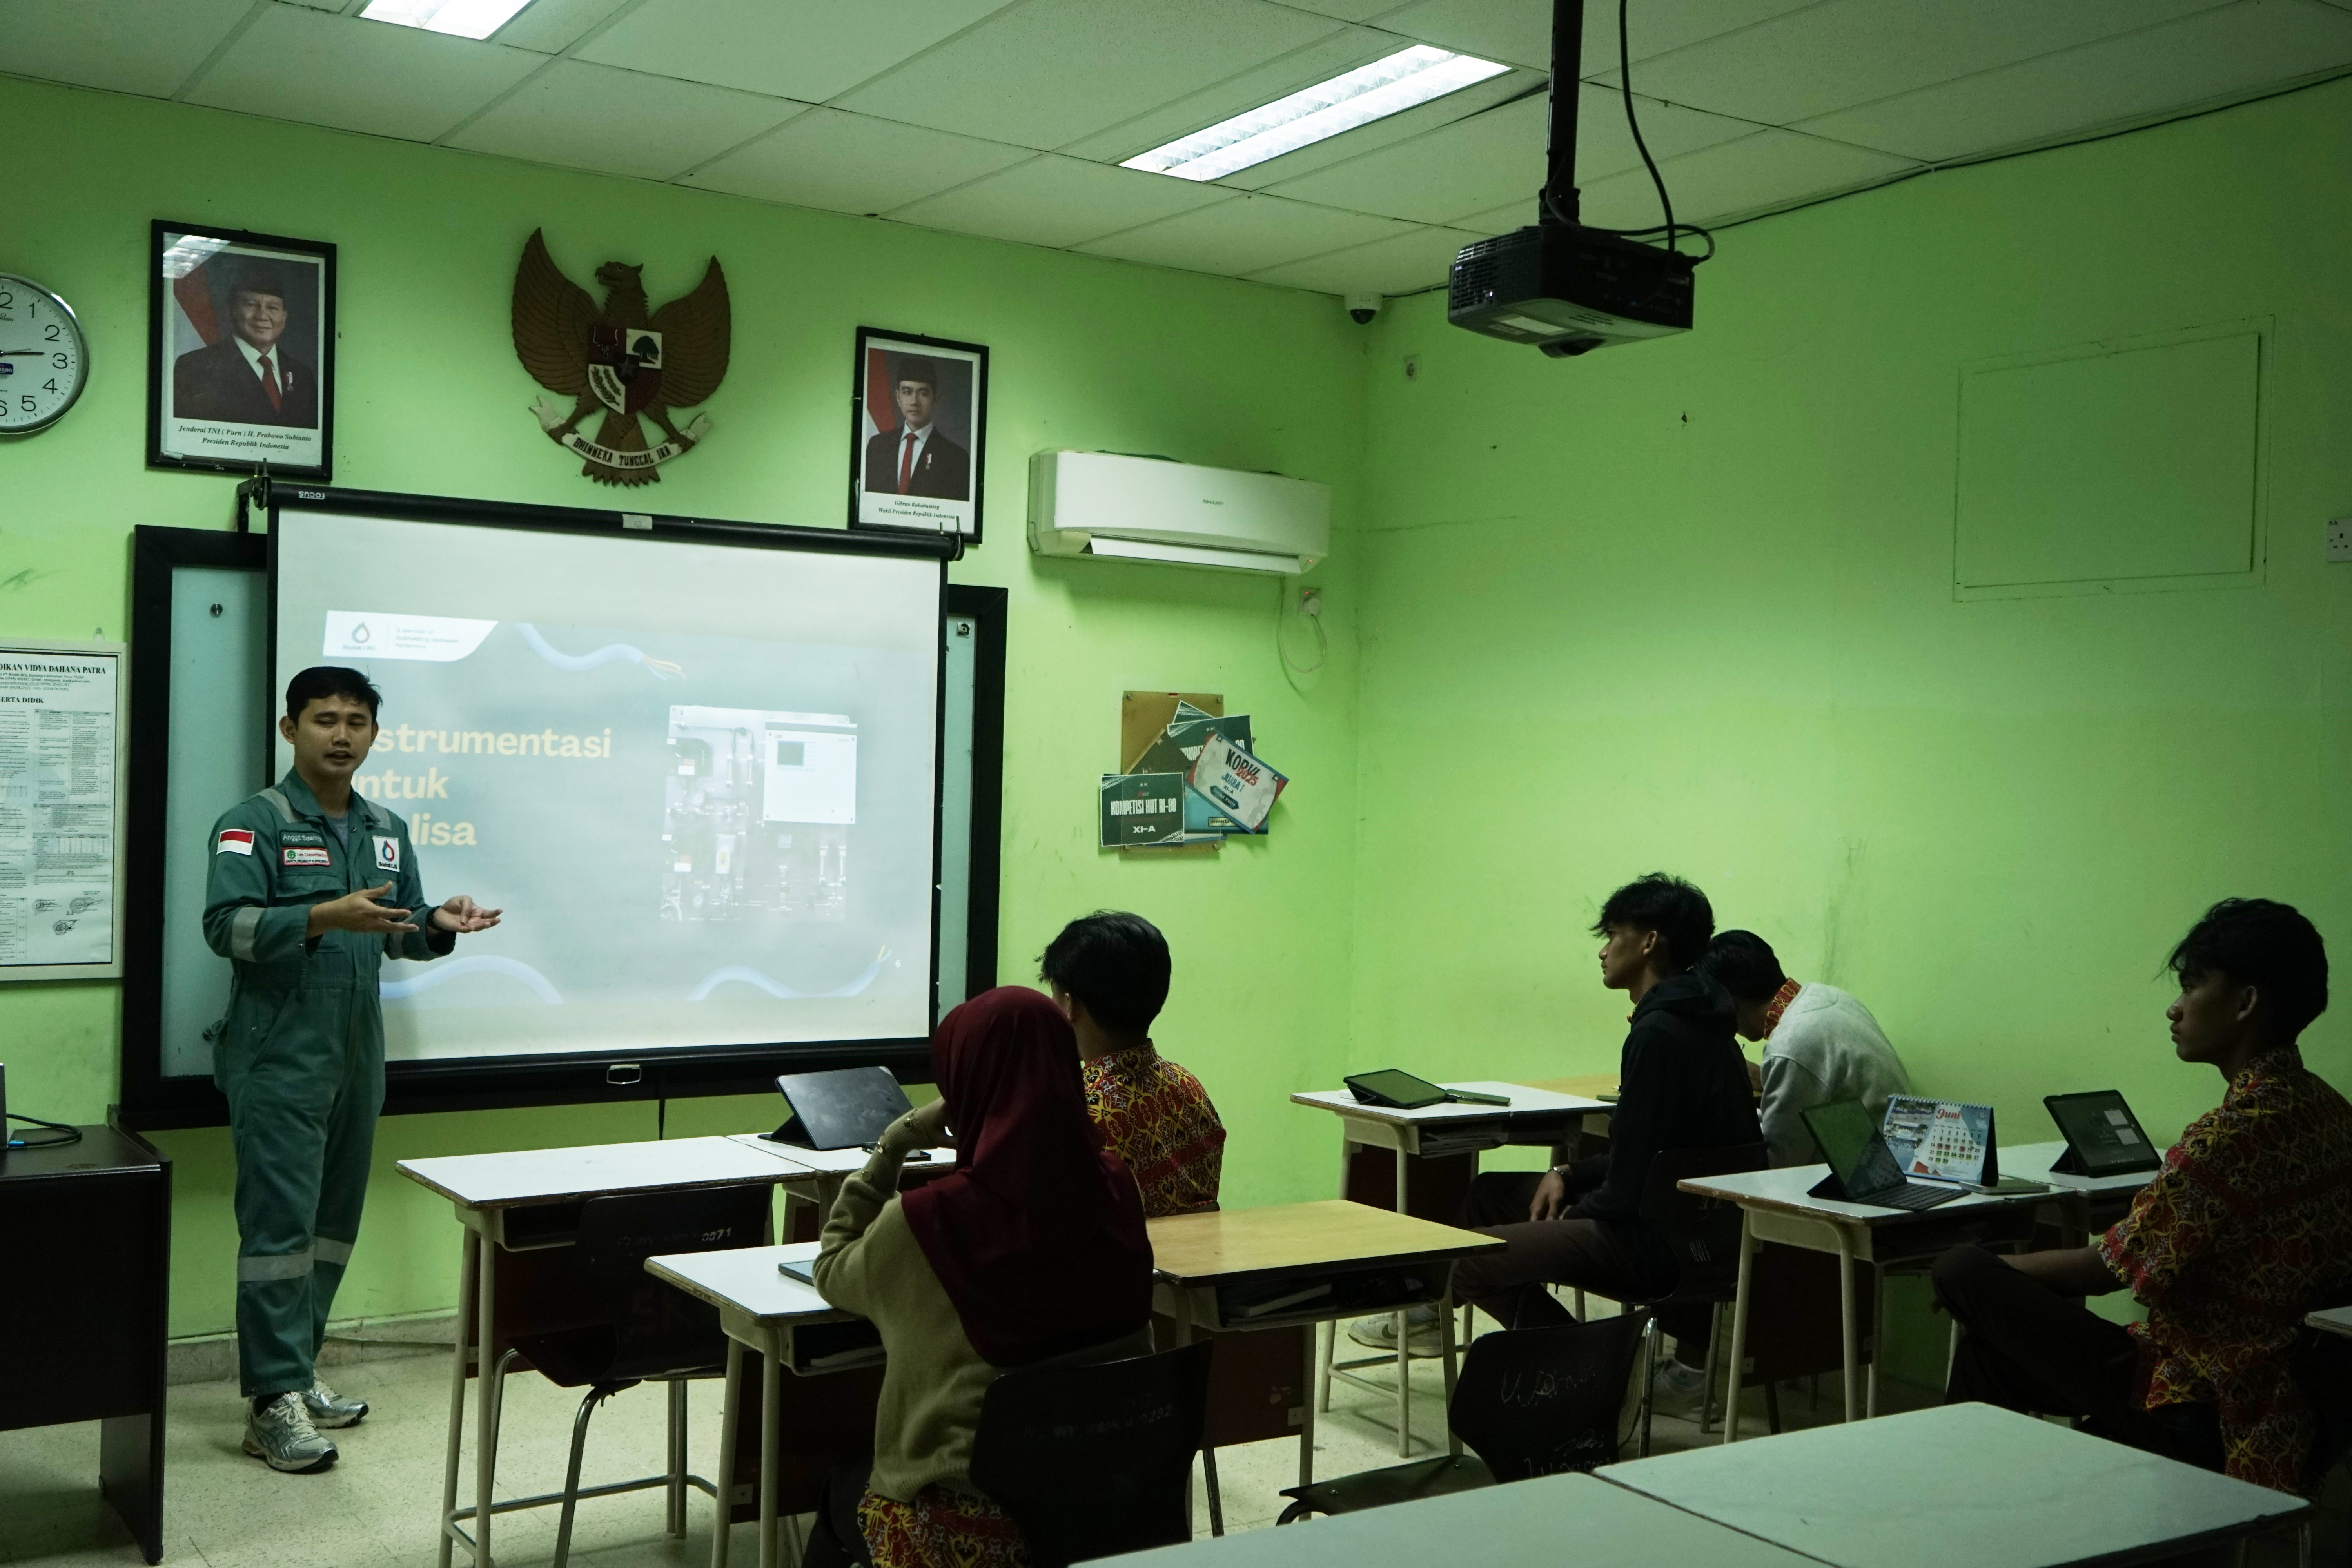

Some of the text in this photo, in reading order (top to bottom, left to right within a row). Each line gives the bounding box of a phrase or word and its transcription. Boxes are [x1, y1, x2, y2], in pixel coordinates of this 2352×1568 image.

[0, 292, 13, 309] 2
[29, 302, 34, 318] 1
[45, 325, 60, 342] 2
[53, 353, 67, 369] 3
[42, 378, 58, 394] 4
[21, 395, 36, 412] 5
[285, 434, 312, 442] Subianto
[573, 437, 671, 466] BHINNEKA TUNGGAL IKA
[371, 723, 612, 758] strumentasi
[1222, 773, 1241, 791] JUARA
[1236, 767, 1259, 786] 2025
[1223, 785, 1233, 795] XI-A
[1111, 798, 1176, 816] KOMPETISI HUT RI-80
[411, 813, 477, 846] lisa
[1133, 825, 1156, 833] XI-A
